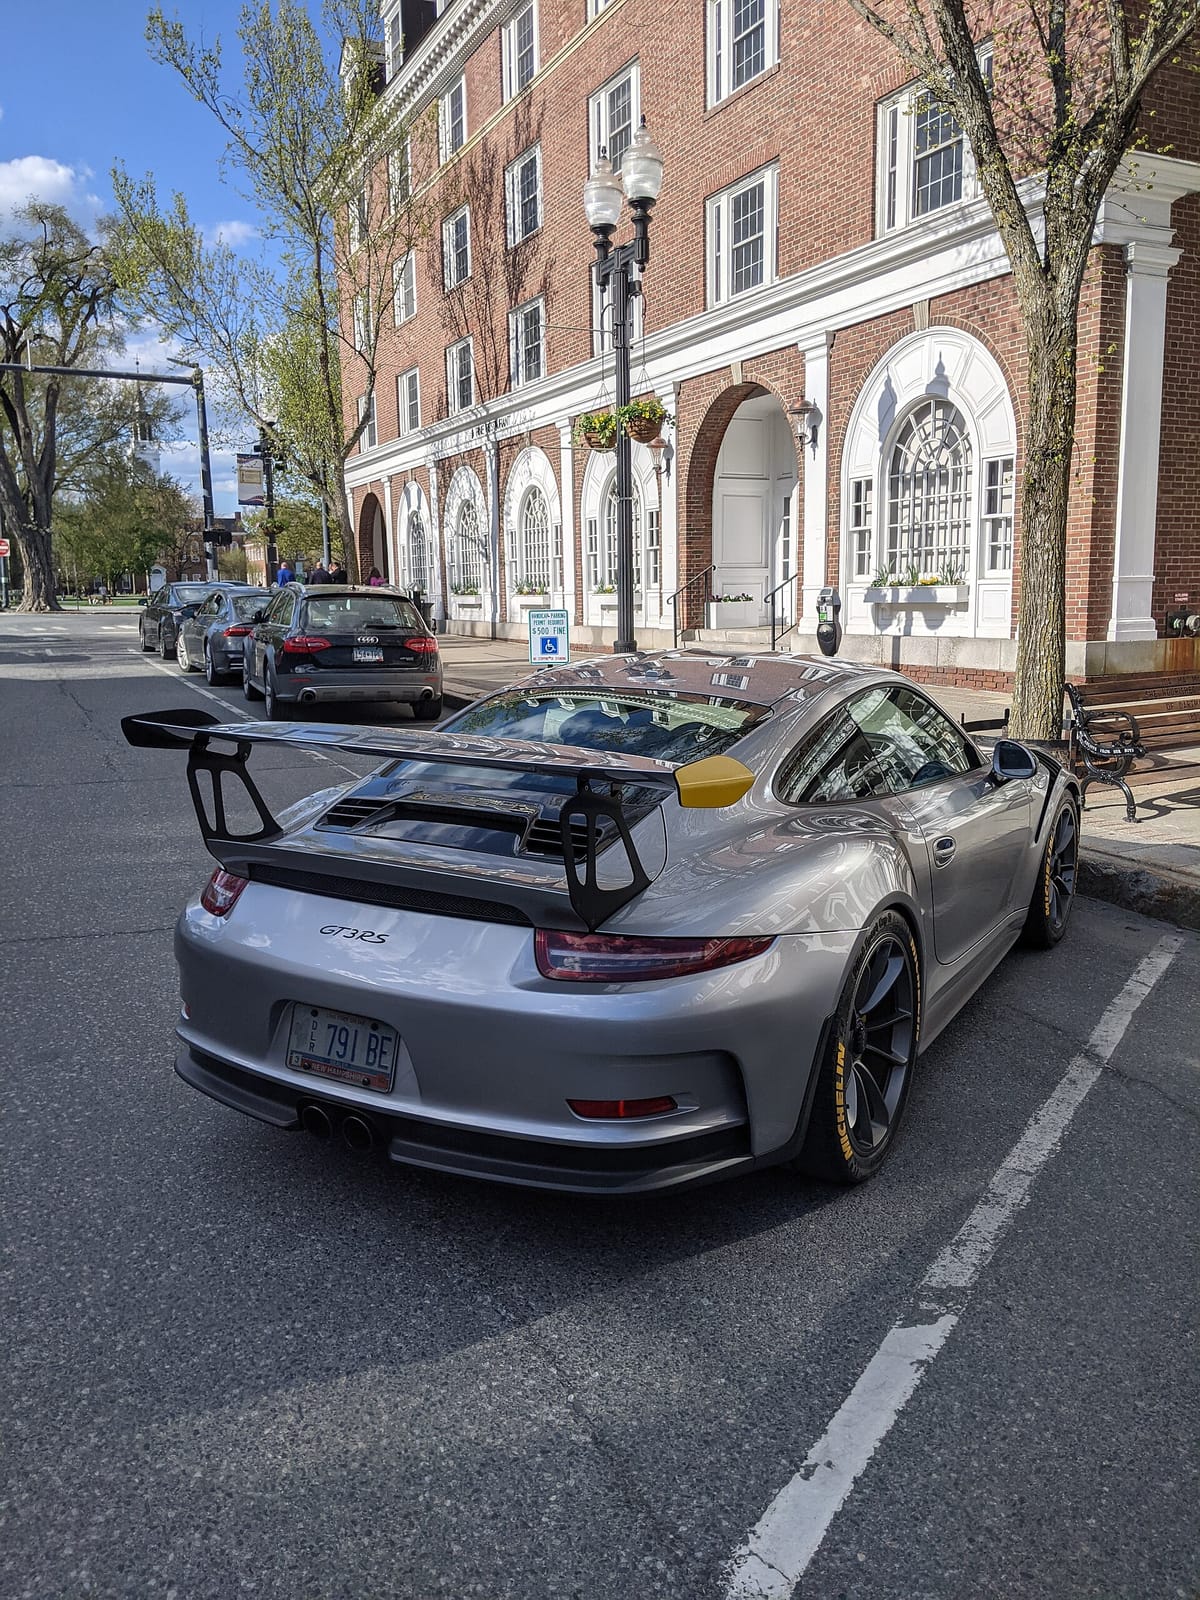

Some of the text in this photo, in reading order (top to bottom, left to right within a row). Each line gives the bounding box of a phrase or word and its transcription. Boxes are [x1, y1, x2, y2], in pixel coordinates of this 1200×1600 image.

[532, 627, 566, 635] $500 FINE
[309, 1020, 317, 1053] DLR
[327, 1023, 392, 1070] 791 BE
[311, 1063, 327, 1072] NEW
[835, 1041, 854, 1161] MICHELIN
